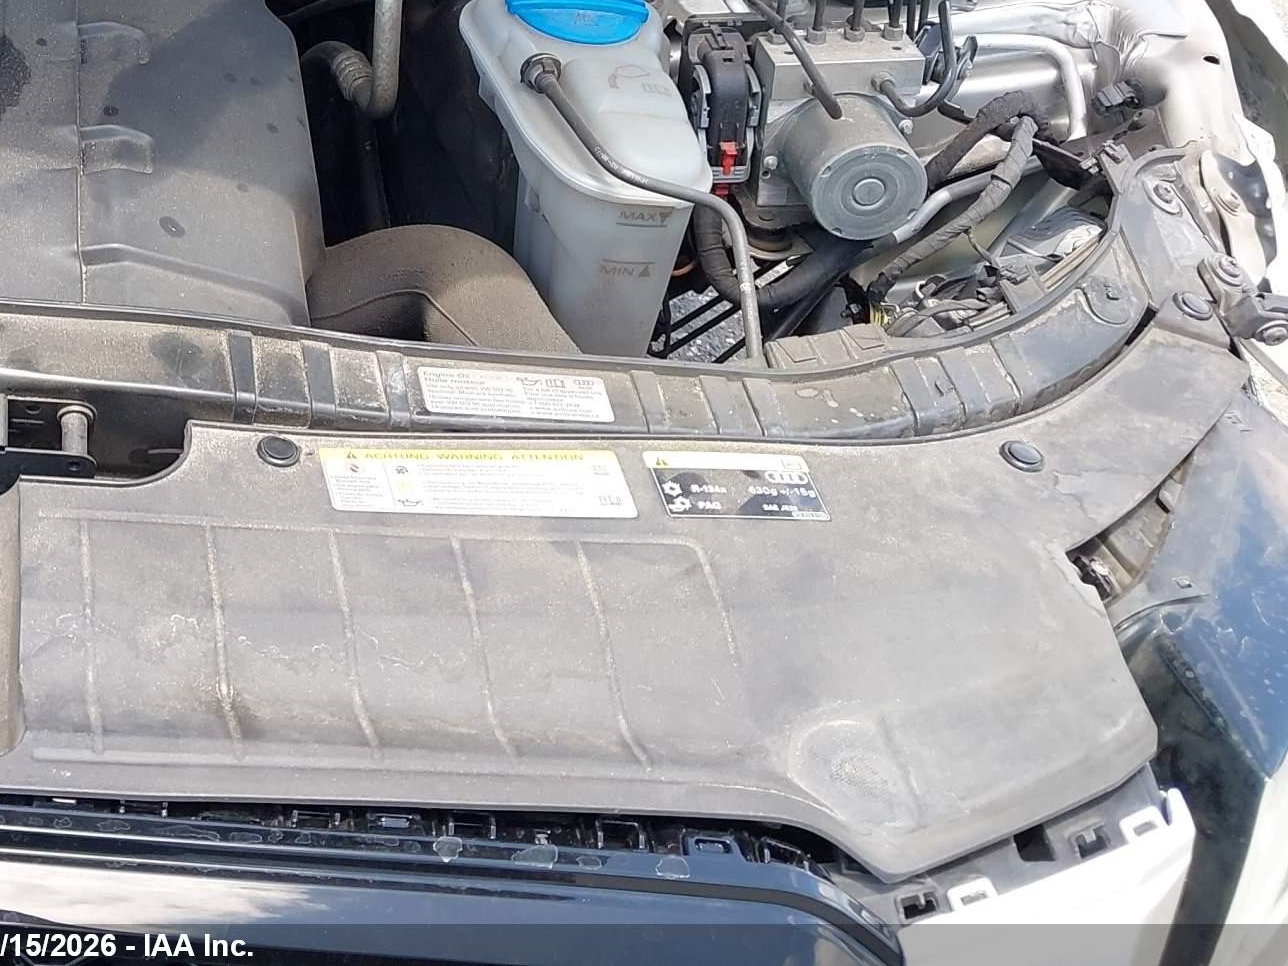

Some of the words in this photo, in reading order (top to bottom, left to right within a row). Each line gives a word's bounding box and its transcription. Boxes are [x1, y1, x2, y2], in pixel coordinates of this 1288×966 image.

[619, 210, 658, 222] MAX
[600, 265, 634, 276] MIN
[364, 451, 430, 460] ACHTUNG
[438, 452, 504, 461] WARNING
[511, 453, 585, 462] ATTENTION
